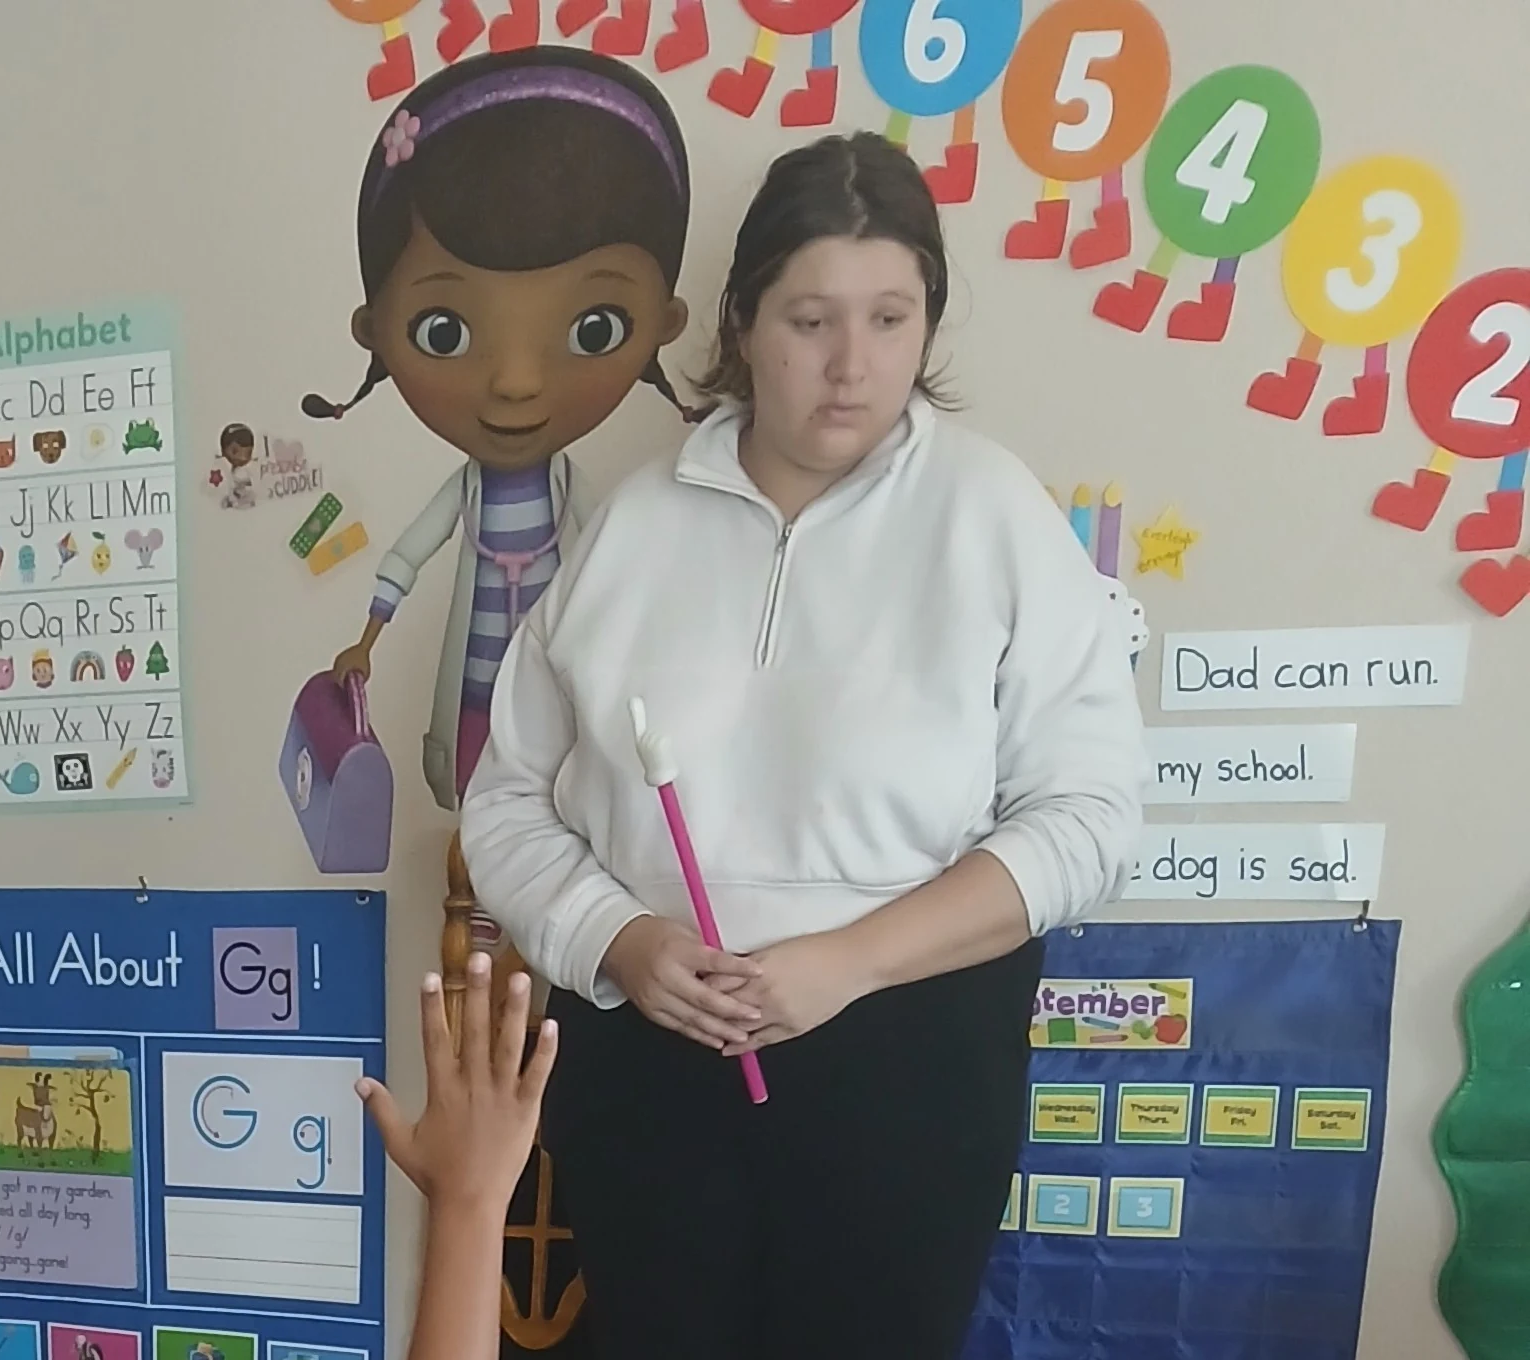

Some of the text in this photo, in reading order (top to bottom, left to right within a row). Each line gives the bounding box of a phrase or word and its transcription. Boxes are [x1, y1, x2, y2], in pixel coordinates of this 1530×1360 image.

[903, 0, 967, 84] 6
[1052, 30, 1124, 152] 5
[1175, 98, 1269, 224] 4
[1325, 189, 1422, 312] 3
[1450, 301, 1530, 426] 2
[30, 378, 65, 418] Dd
[83, 373, 115, 413] Ee
[130, 367, 156, 408] Ff
[10, 488, 35, 538] Jj
[47, 486, 75, 523] Kk
[89, 482, 111, 519] Ll
[122, 479, 170, 517] Mm
[19, 602, 64, 645] Qq
[76, 598, 100, 636] Rr
[109, 596, 135, 634] Ss
[144, 594, 167, 632] Tt
[1175, 645, 1440, 693] Dad can run.
[53, 707, 82, 743] Xx
[96, 705, 131, 752] Yy
[145, 702, 174, 740] Zz
[1157, 744, 1314, 795] my school.
[1152, 838, 1358, 898] dog is sad.
[49, 932, 182, 986] About
[220, 942, 292, 1020] Gg
[312, 944, 321, 989] !
[192, 1075, 326, 1190] G g
[1130, 1103, 1179, 1115] Thursday
[1223, 1105, 1257, 1117] Friday
[1307, 1108, 1356, 1121] Saturday
[2, 1177, 20, 1199] got
[27, 1183, 37, 1193] in
[42, 1185, 61, 1203] my
[19, 1202, 32, 1218] all
[38, 1204, 60, 1227] day
[1053, 1194, 1071, 1215] 2
[1136, 1197, 1153, 1218] 3
[7, 1225, 29, 1249] /g/
